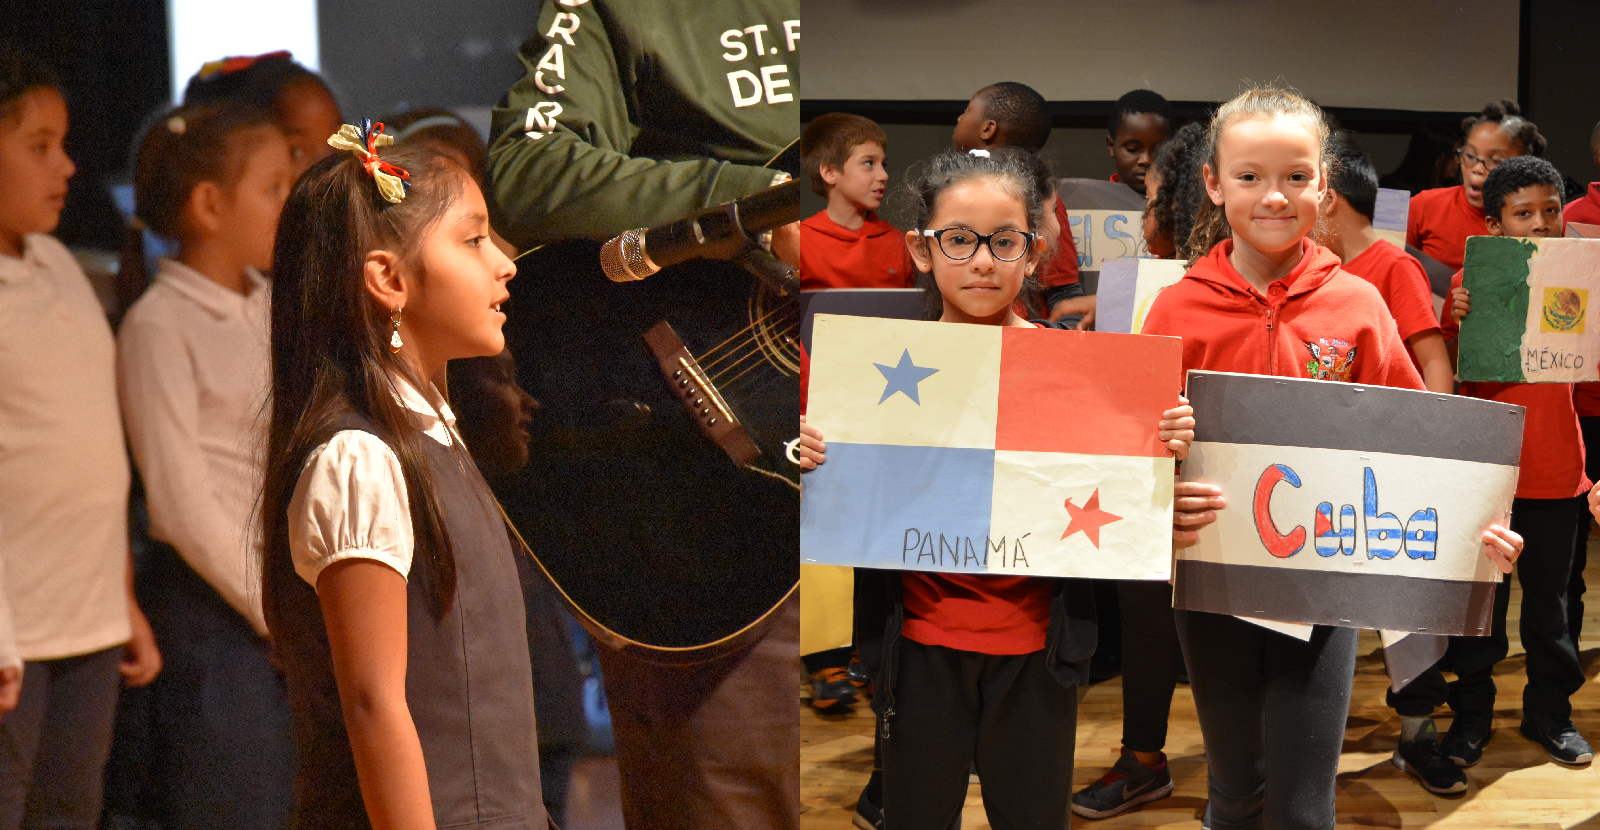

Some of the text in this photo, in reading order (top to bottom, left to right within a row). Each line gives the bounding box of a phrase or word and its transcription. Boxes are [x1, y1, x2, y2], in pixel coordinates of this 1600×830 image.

[719, 24, 778, 62] ST.
[726, 64, 794, 108] DE
[1525, 346, 1584, 373] MÉXICO
[1252, 463, 1439, 560] Cuba
[902, 527, 1031, 569] PANAMÁ
